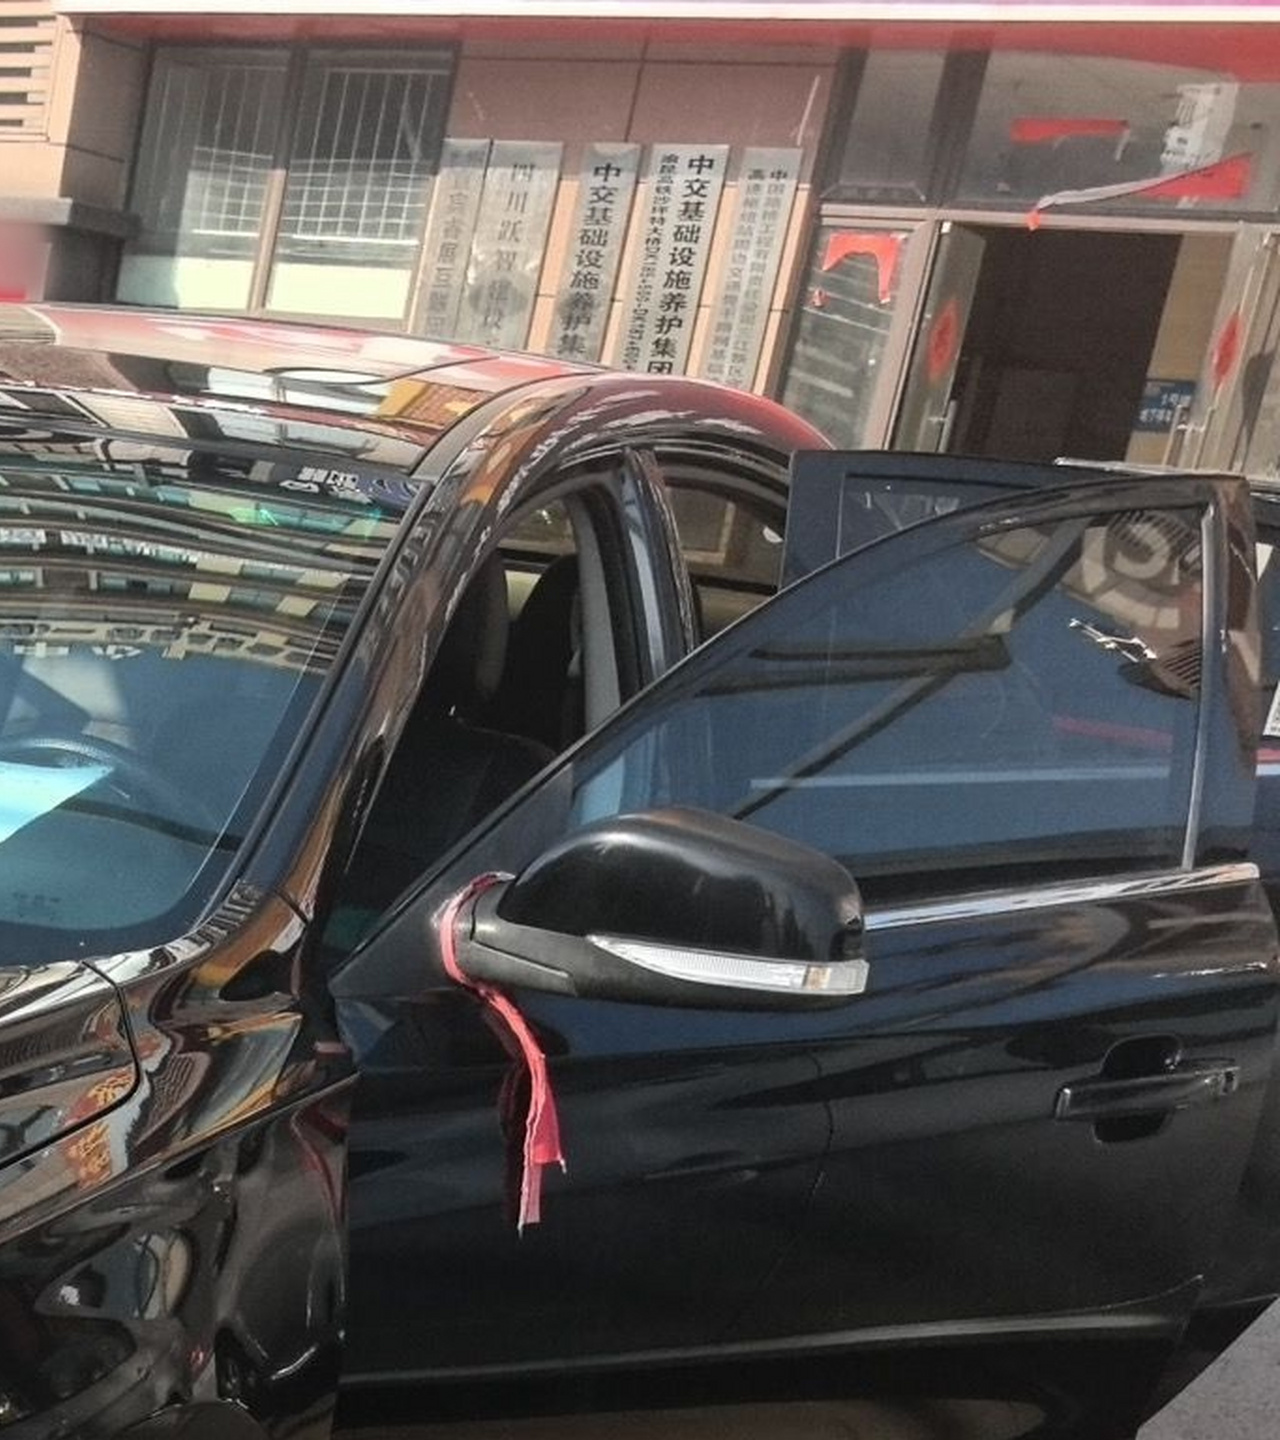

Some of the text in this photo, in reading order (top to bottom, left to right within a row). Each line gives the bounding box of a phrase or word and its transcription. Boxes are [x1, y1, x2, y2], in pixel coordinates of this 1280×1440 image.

[558, 162, 622, 355] 中交基础设施养护集
